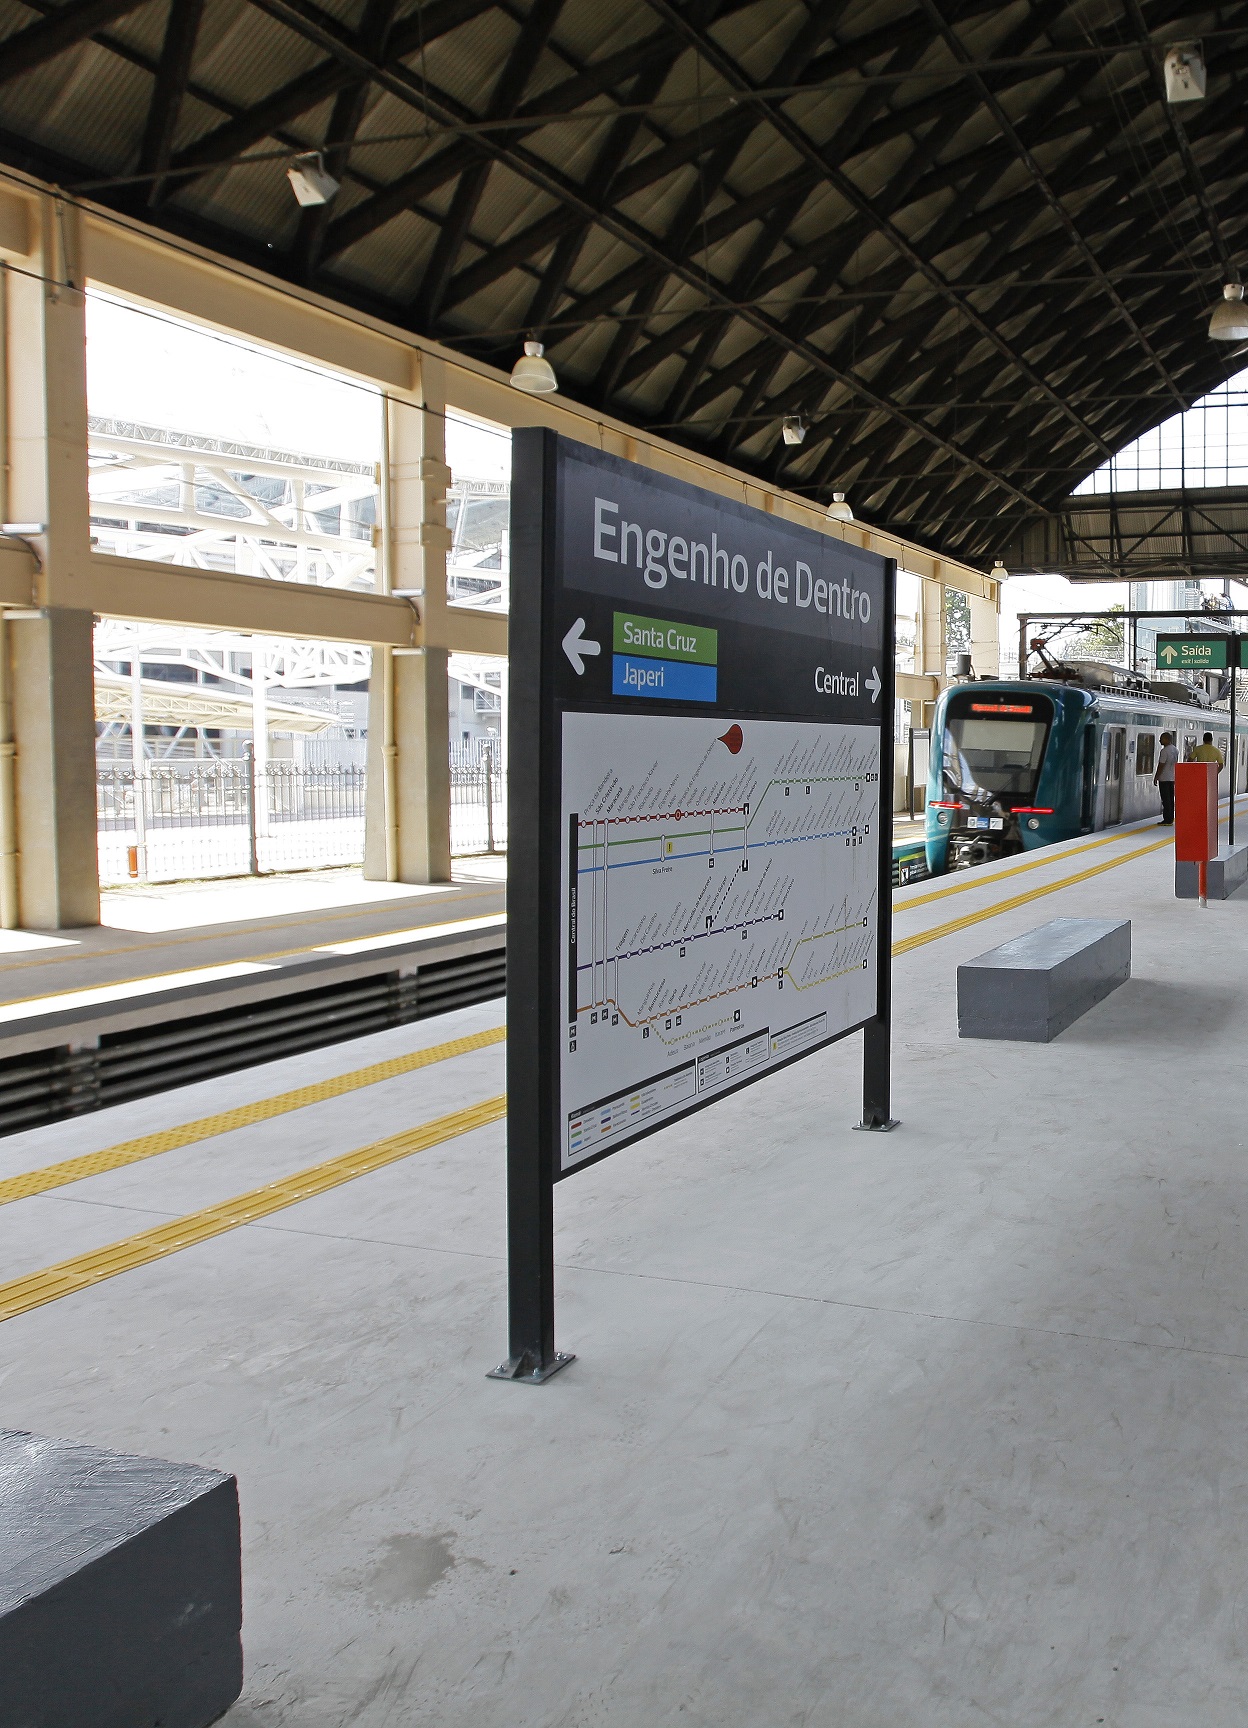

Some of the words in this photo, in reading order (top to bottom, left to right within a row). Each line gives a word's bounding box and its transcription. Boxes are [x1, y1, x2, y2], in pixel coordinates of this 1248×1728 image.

[593, 497, 748, 593] Engenho
[756, 550, 789, 604] de
[795, 561, 871, 624] Dentro
[623, 622, 664, 650] Santa
[666, 628, 697, 654] Cruz
[1181, 645, 1212, 656] Saída
[622, 662, 664, 692] Japeri
[814, 666, 860, 698] Central
